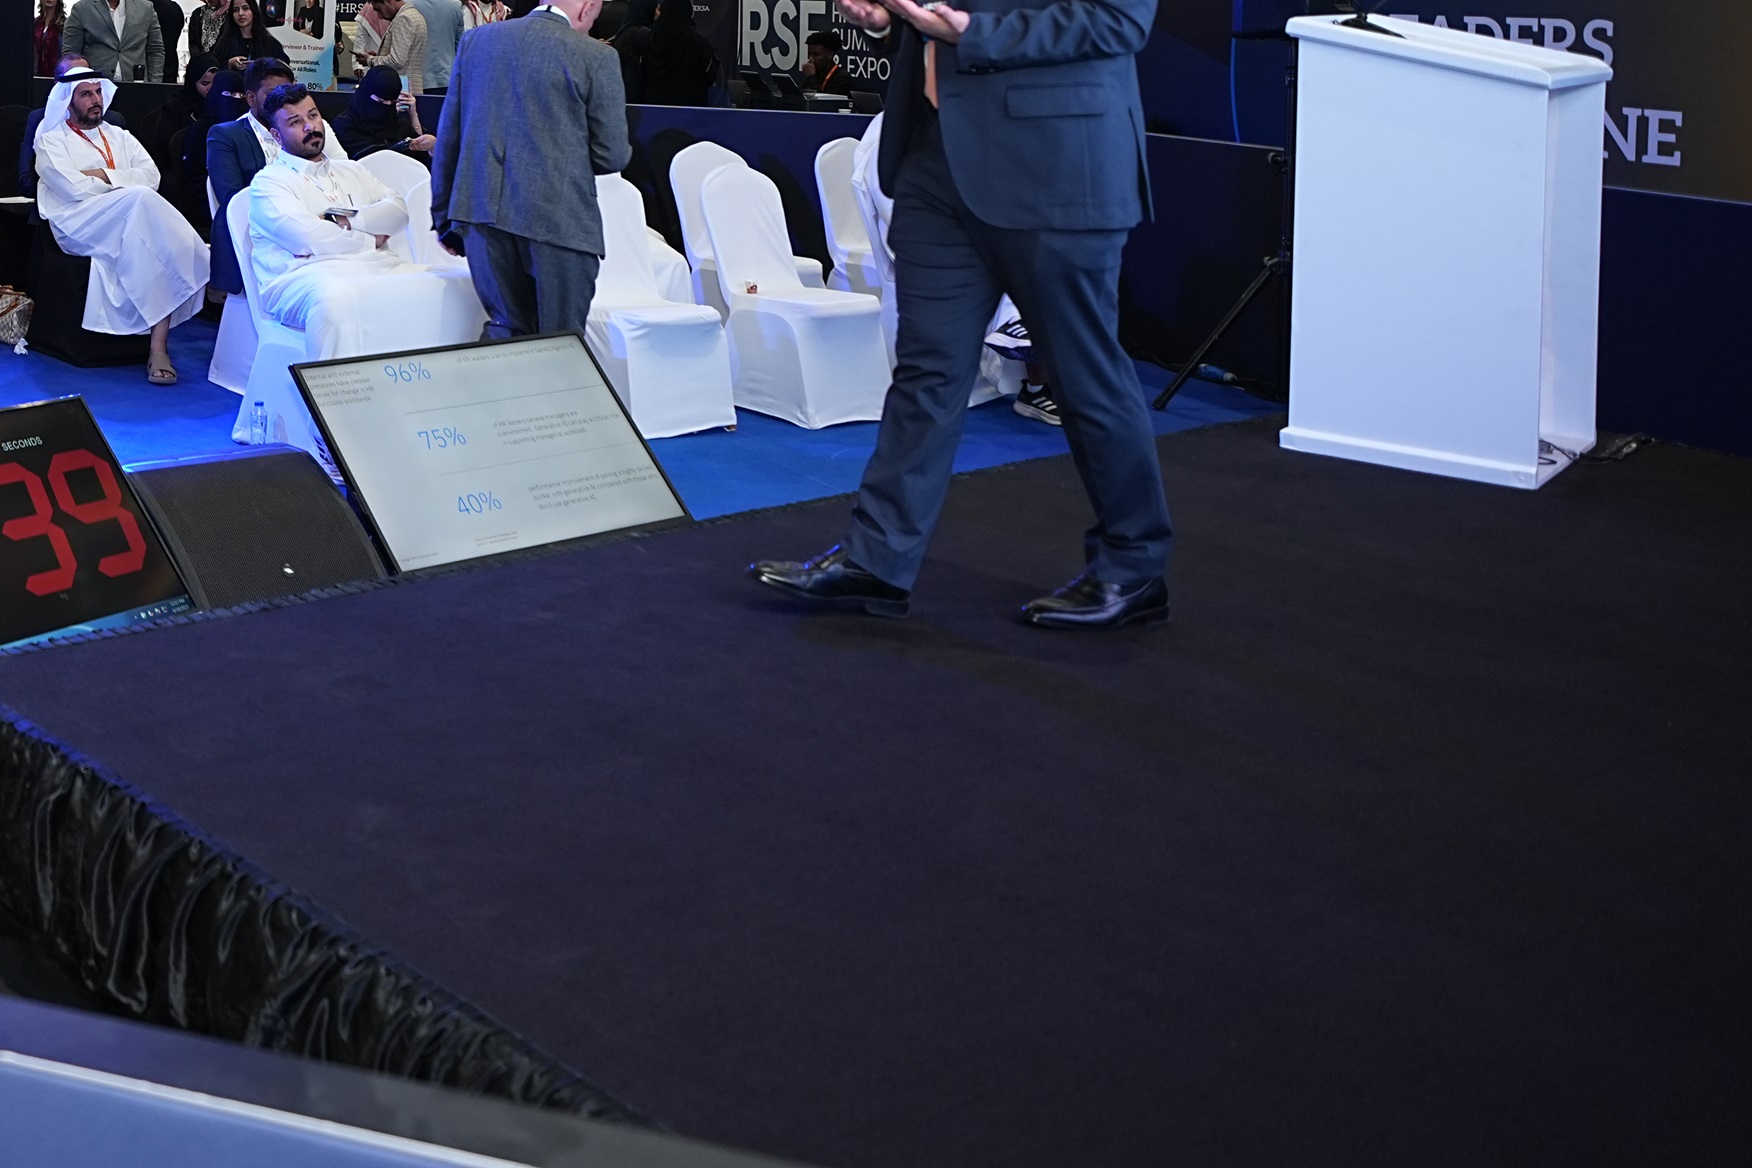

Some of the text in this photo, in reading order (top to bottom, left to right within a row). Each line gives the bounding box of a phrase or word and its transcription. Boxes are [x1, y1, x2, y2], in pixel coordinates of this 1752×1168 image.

[846, 55, 891, 81] EXPO
[307, 82, 324, 91] 80%
[383, 361, 432, 384] 96%
[1, 436, 43, 452] SECONDS
[417, 426, 467, 450] 75%
[457, 491, 503, 515] 40%
